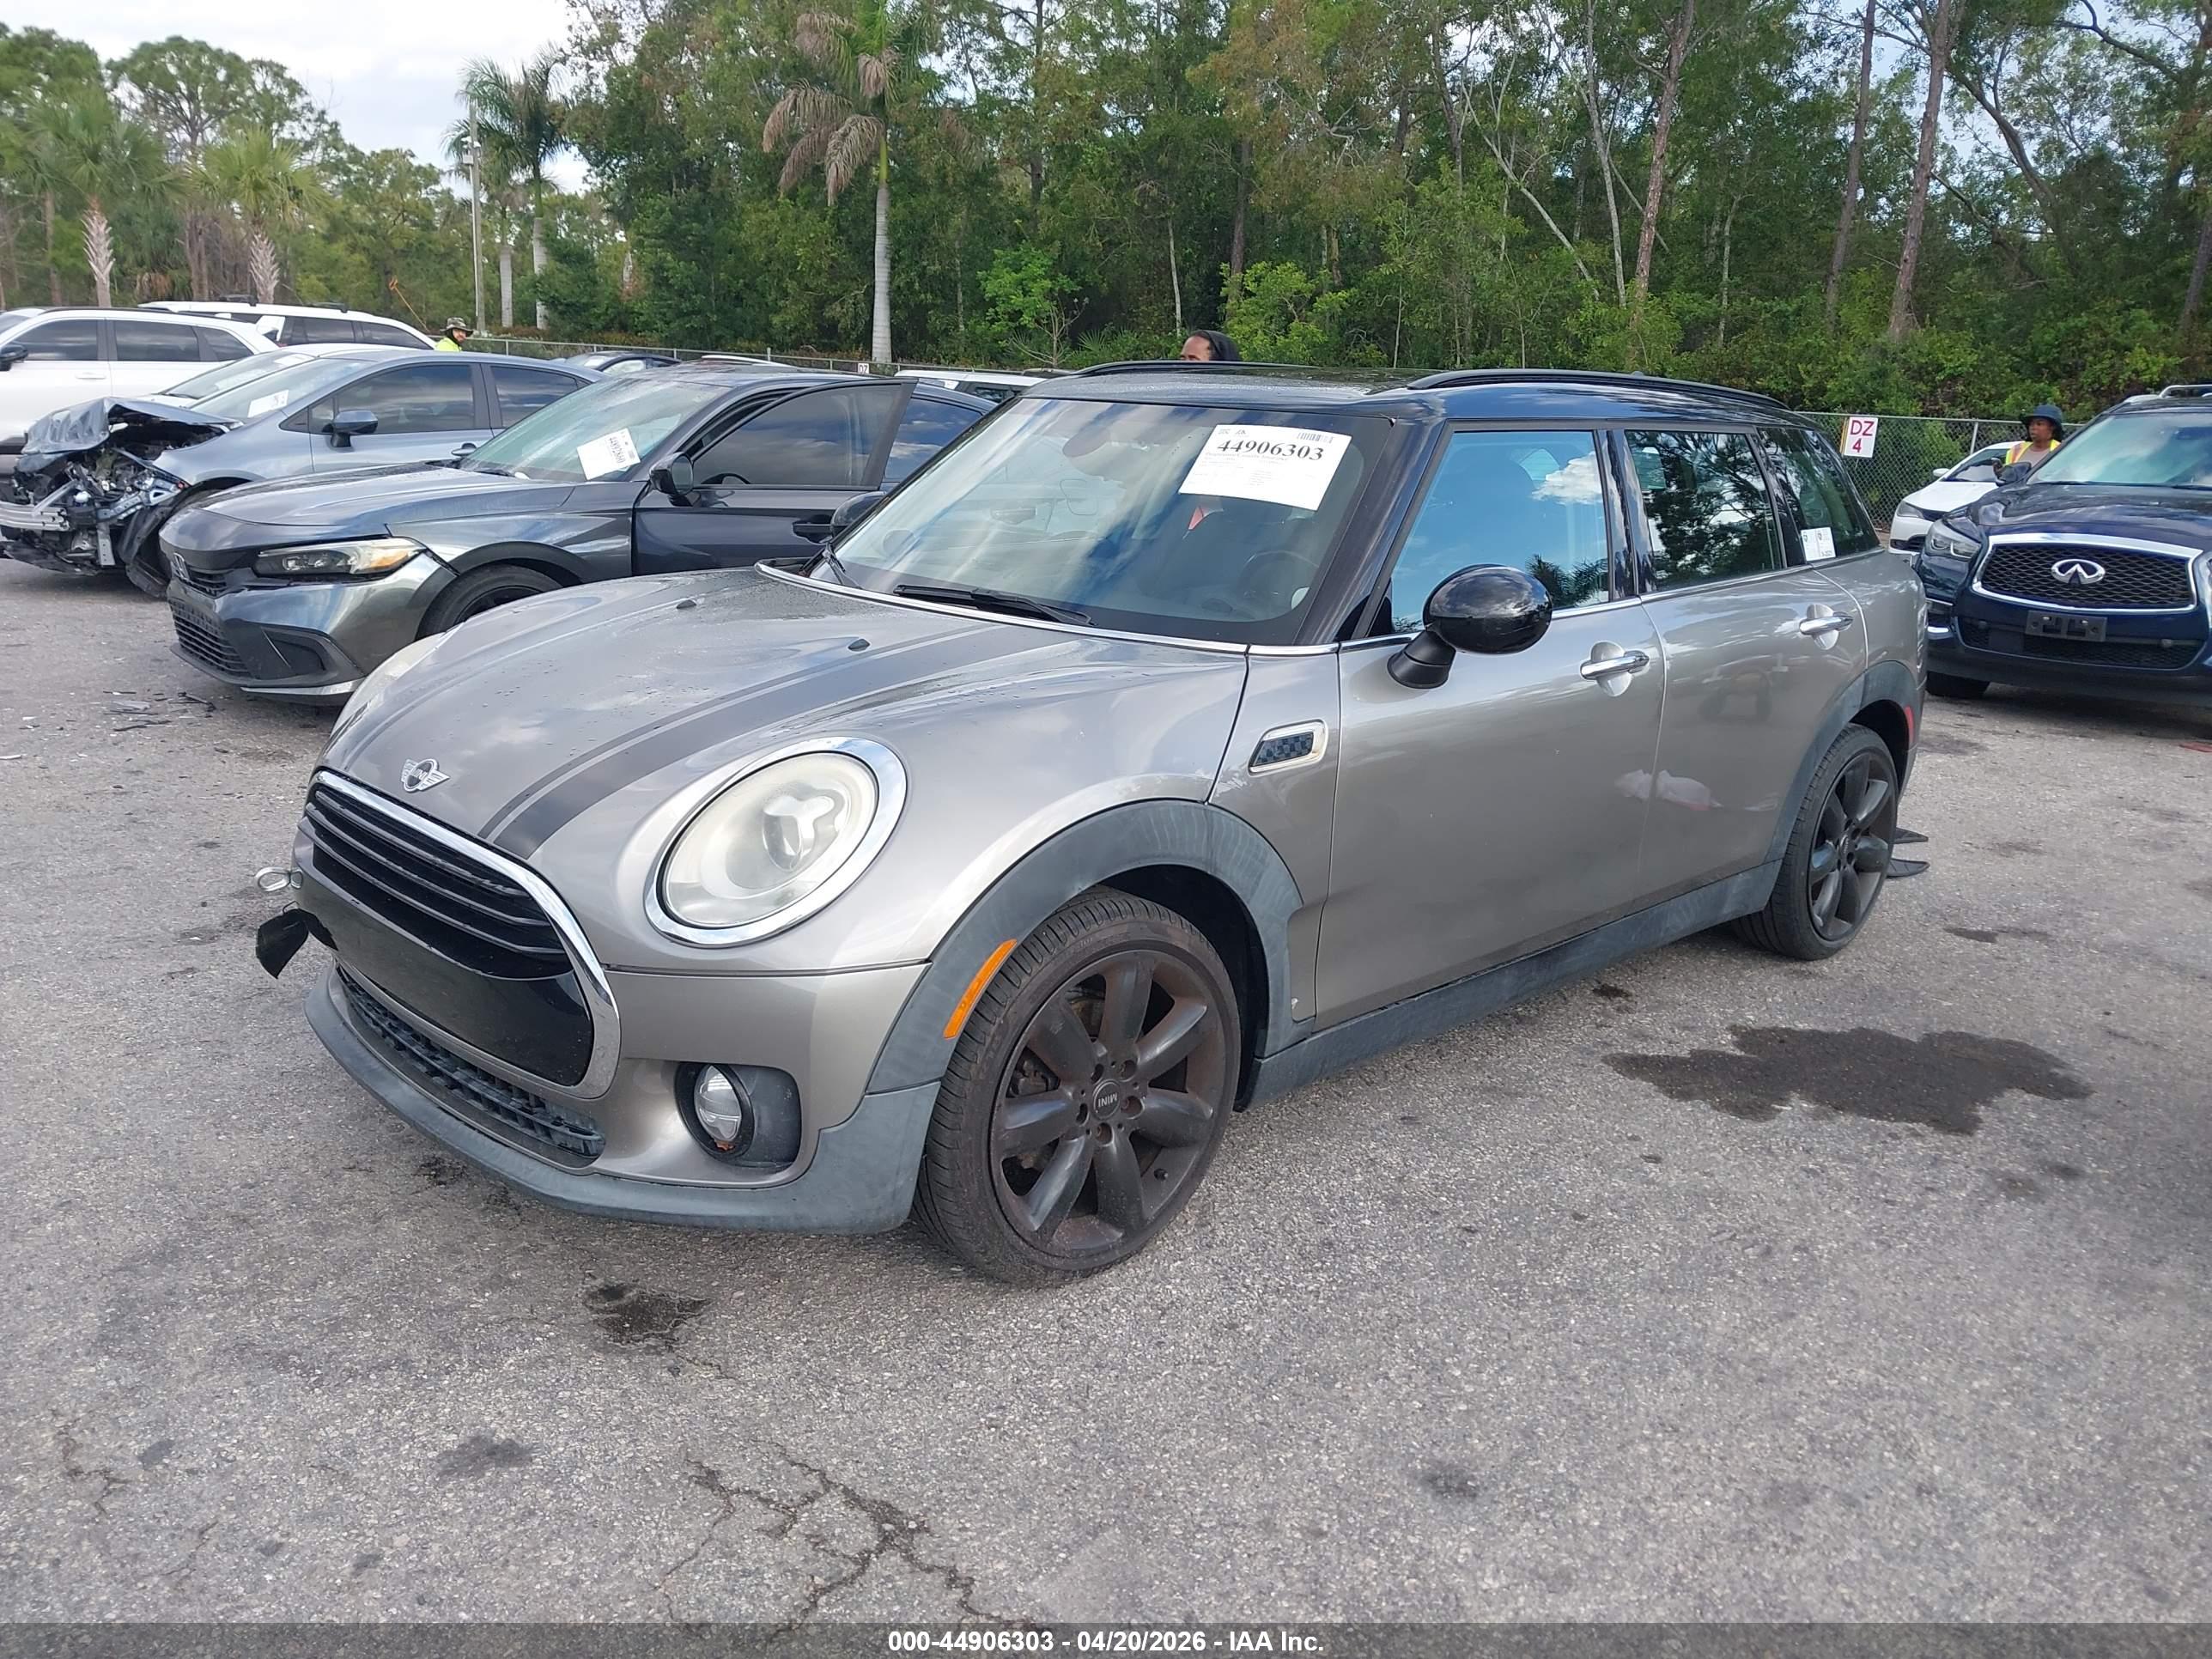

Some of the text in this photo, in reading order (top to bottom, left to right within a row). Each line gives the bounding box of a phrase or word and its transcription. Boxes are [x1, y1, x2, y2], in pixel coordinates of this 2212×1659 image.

[1850, 420, 1875, 436] DZ
[1217, 440, 1323, 461] 44906303
[1852, 438, 1862, 453] 4
[1098, 1092, 1117, 1108] MINI
